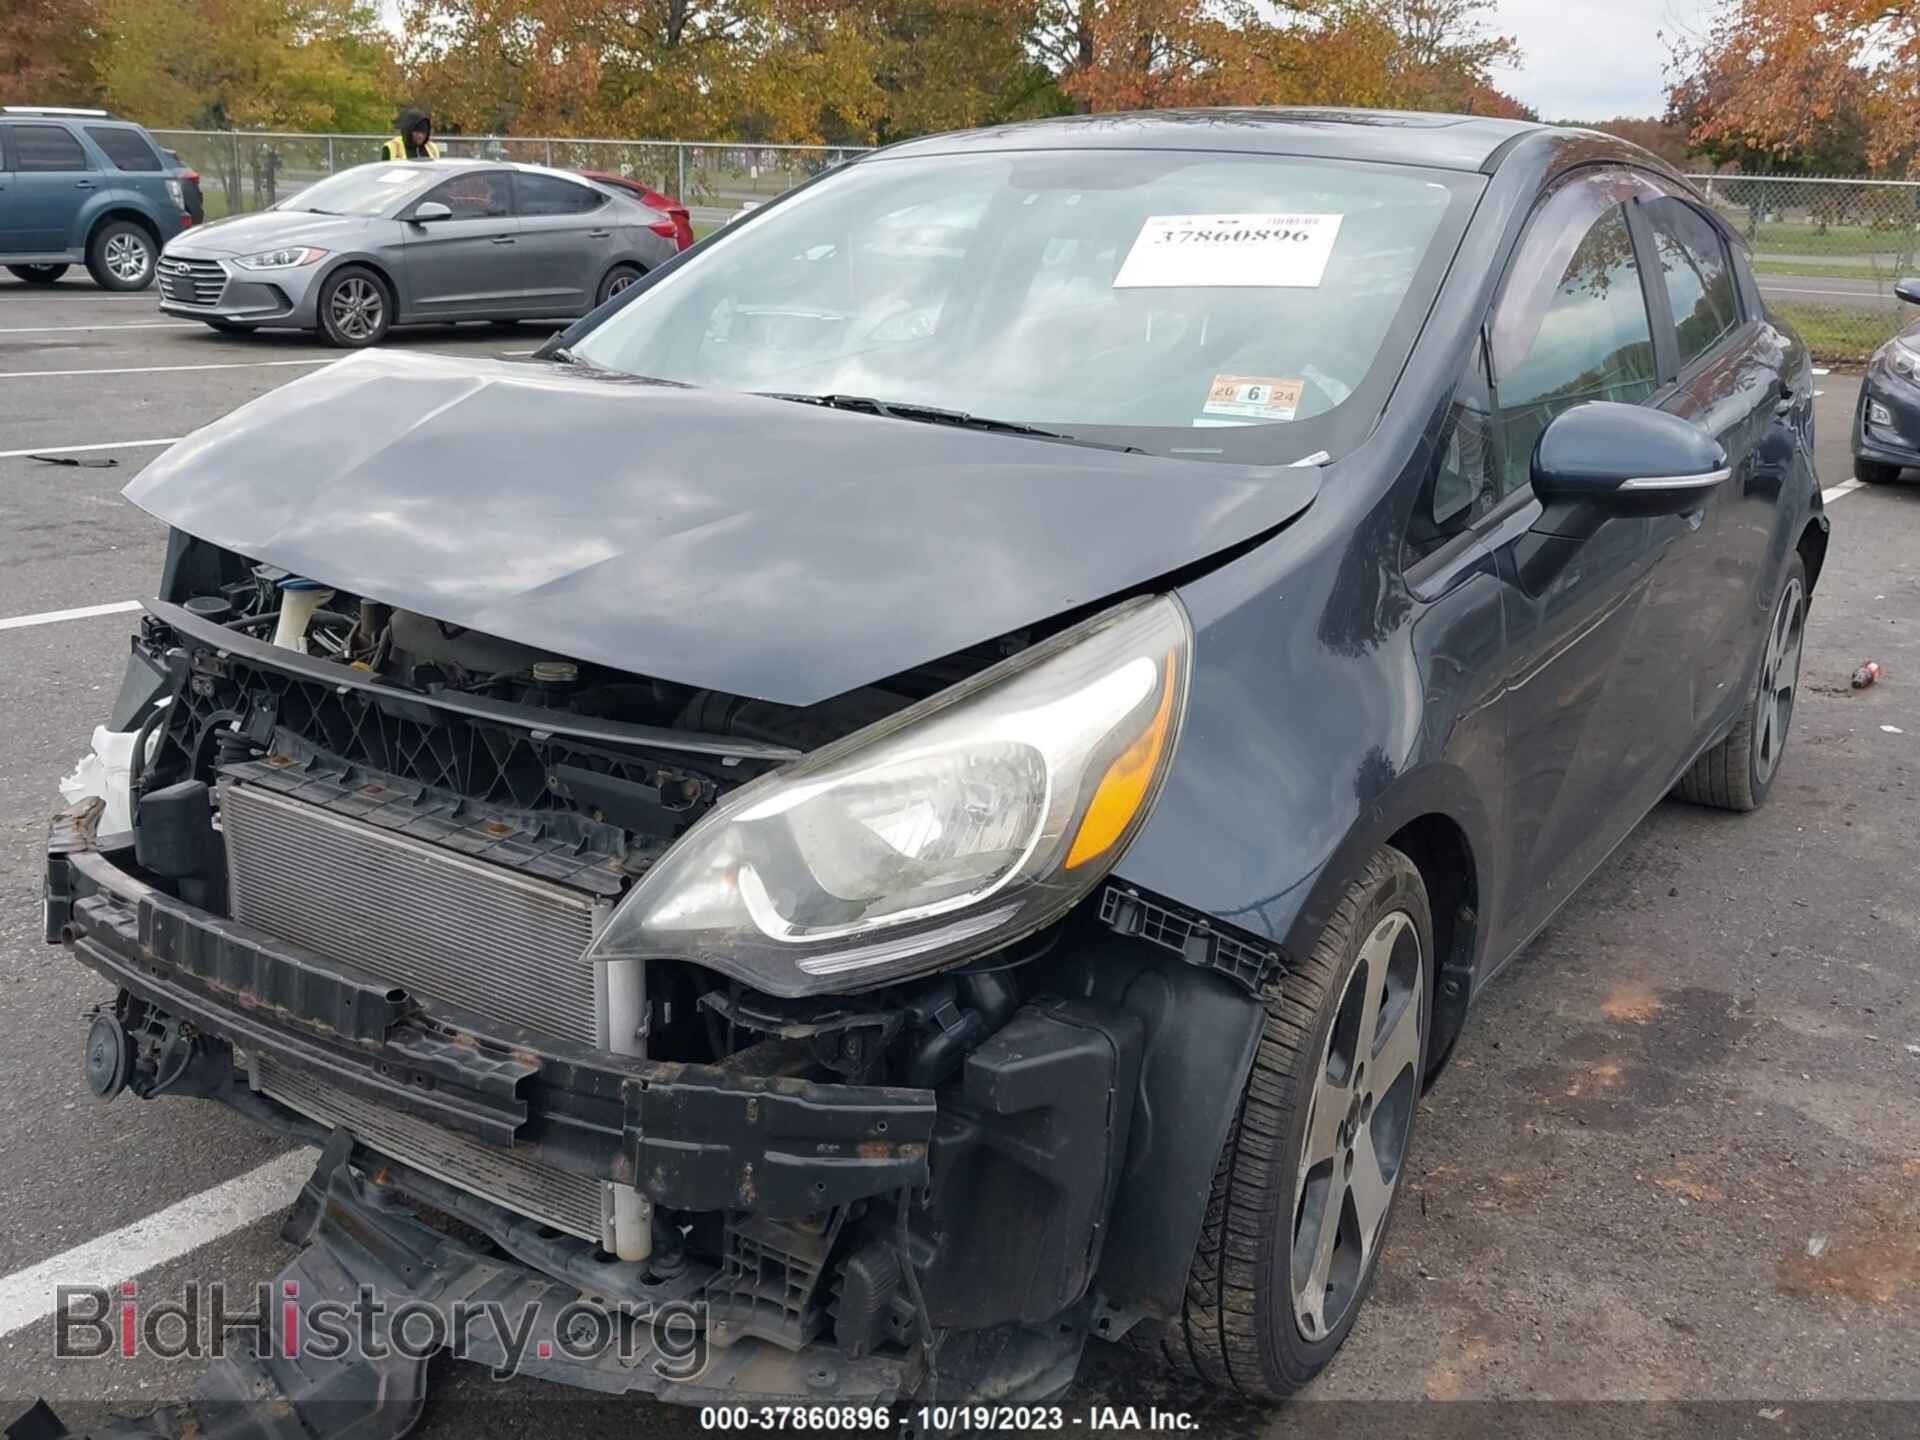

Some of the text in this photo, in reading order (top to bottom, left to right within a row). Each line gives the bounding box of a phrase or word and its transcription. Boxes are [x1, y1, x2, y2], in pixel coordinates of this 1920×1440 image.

[1154, 229, 1310, 245] 37860896
[1214, 386, 1295, 402] 20 6 24
